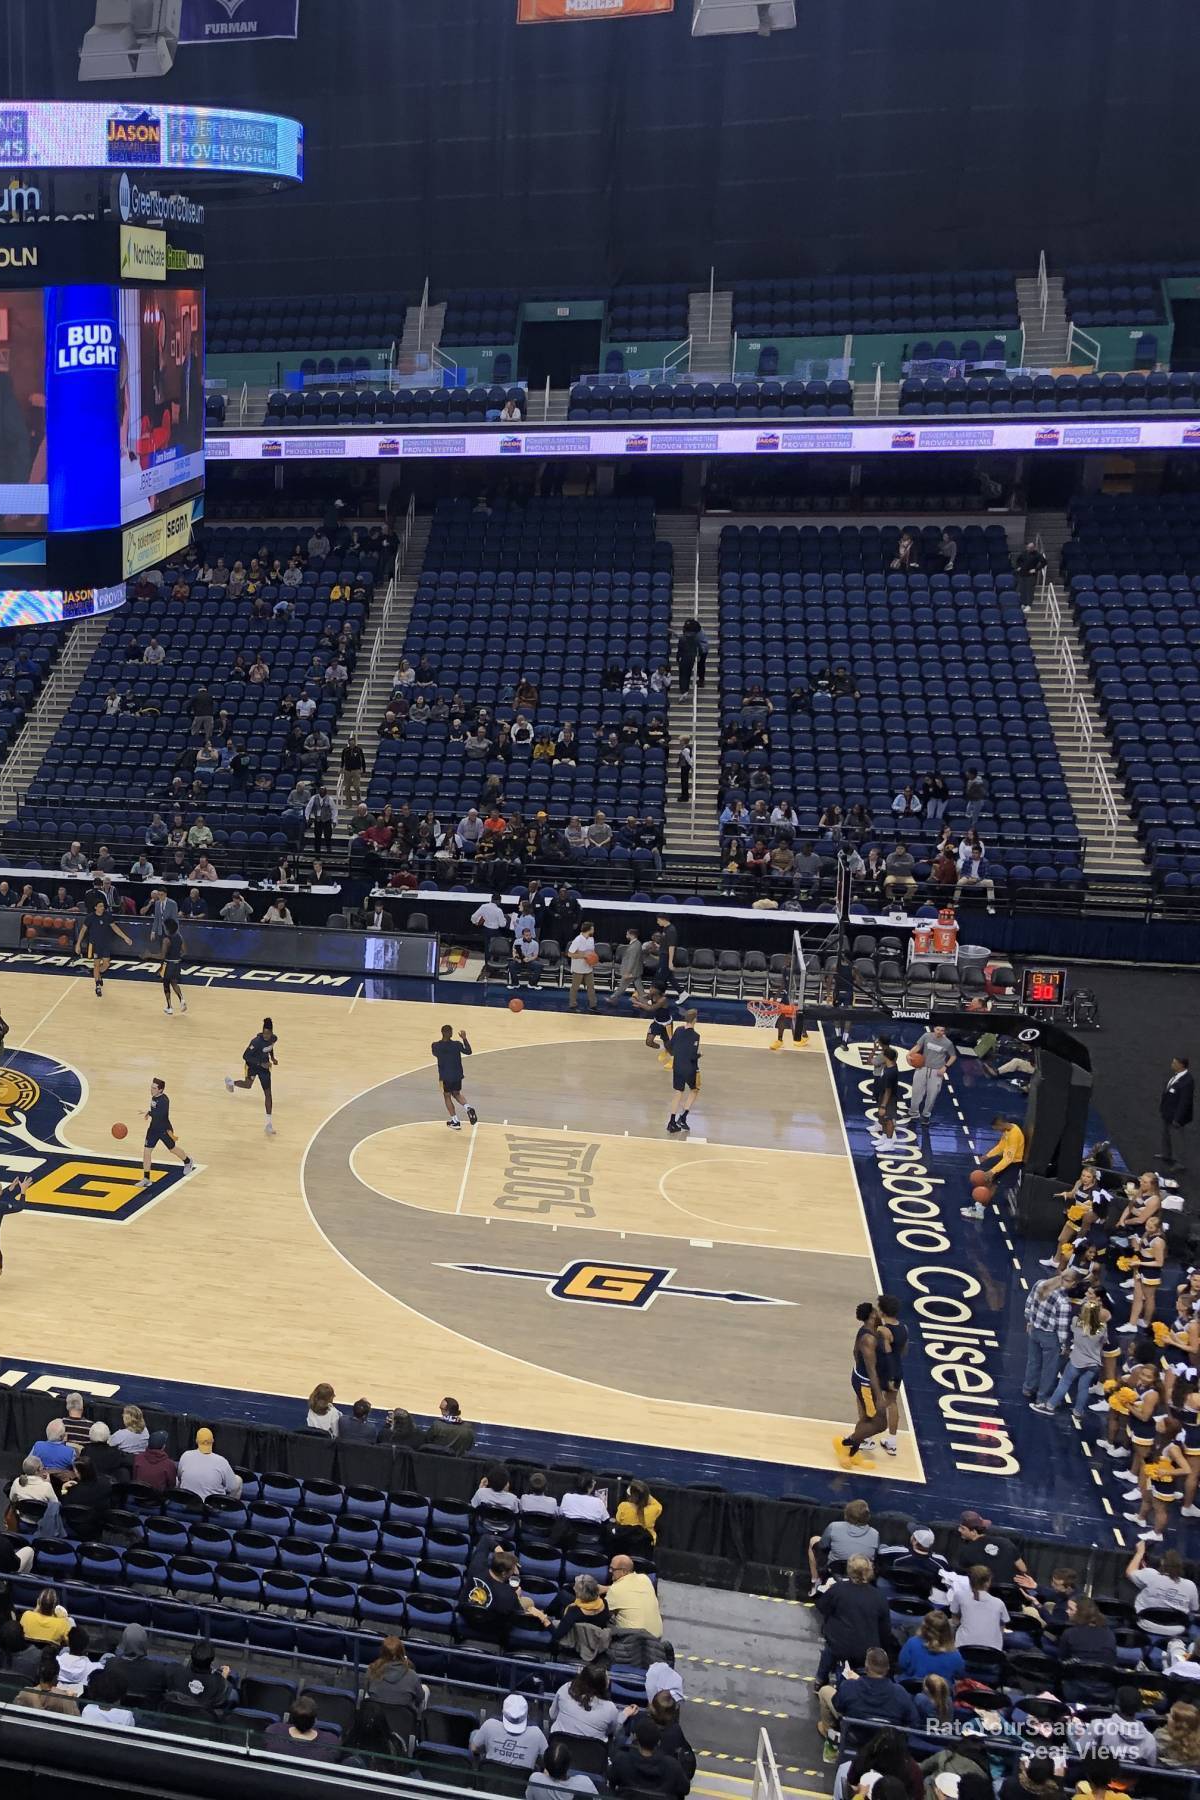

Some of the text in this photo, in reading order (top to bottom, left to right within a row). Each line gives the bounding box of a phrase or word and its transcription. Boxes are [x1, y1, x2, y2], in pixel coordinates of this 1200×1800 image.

[204, 21, 257, 34] FURMAN
[107, 120, 160, 140] JASON
[171, 143, 228, 160] PROVEN
[232, 146, 277, 164] SYSTEMS
[133, 242, 165, 267] NorthState
[68, 325, 112, 346] BUD
[59, 346, 117, 368] LIGHT
[782, 440, 851, 449] PROVEN SYSTEMS
[920, 438, 992, 447] PROVEN SYSTEMS
[166, 514, 188, 538] SEGRA
[63, 589, 94, 603] JASON
[1032, 984, 1053, 1000] 30
[891, 1009, 930, 1020] SPALDING
[555, 1263, 664, 1305] G
[906, 1265, 1020, 1476] Coliseum
[494, 1747, 526, 1760] FORCE
